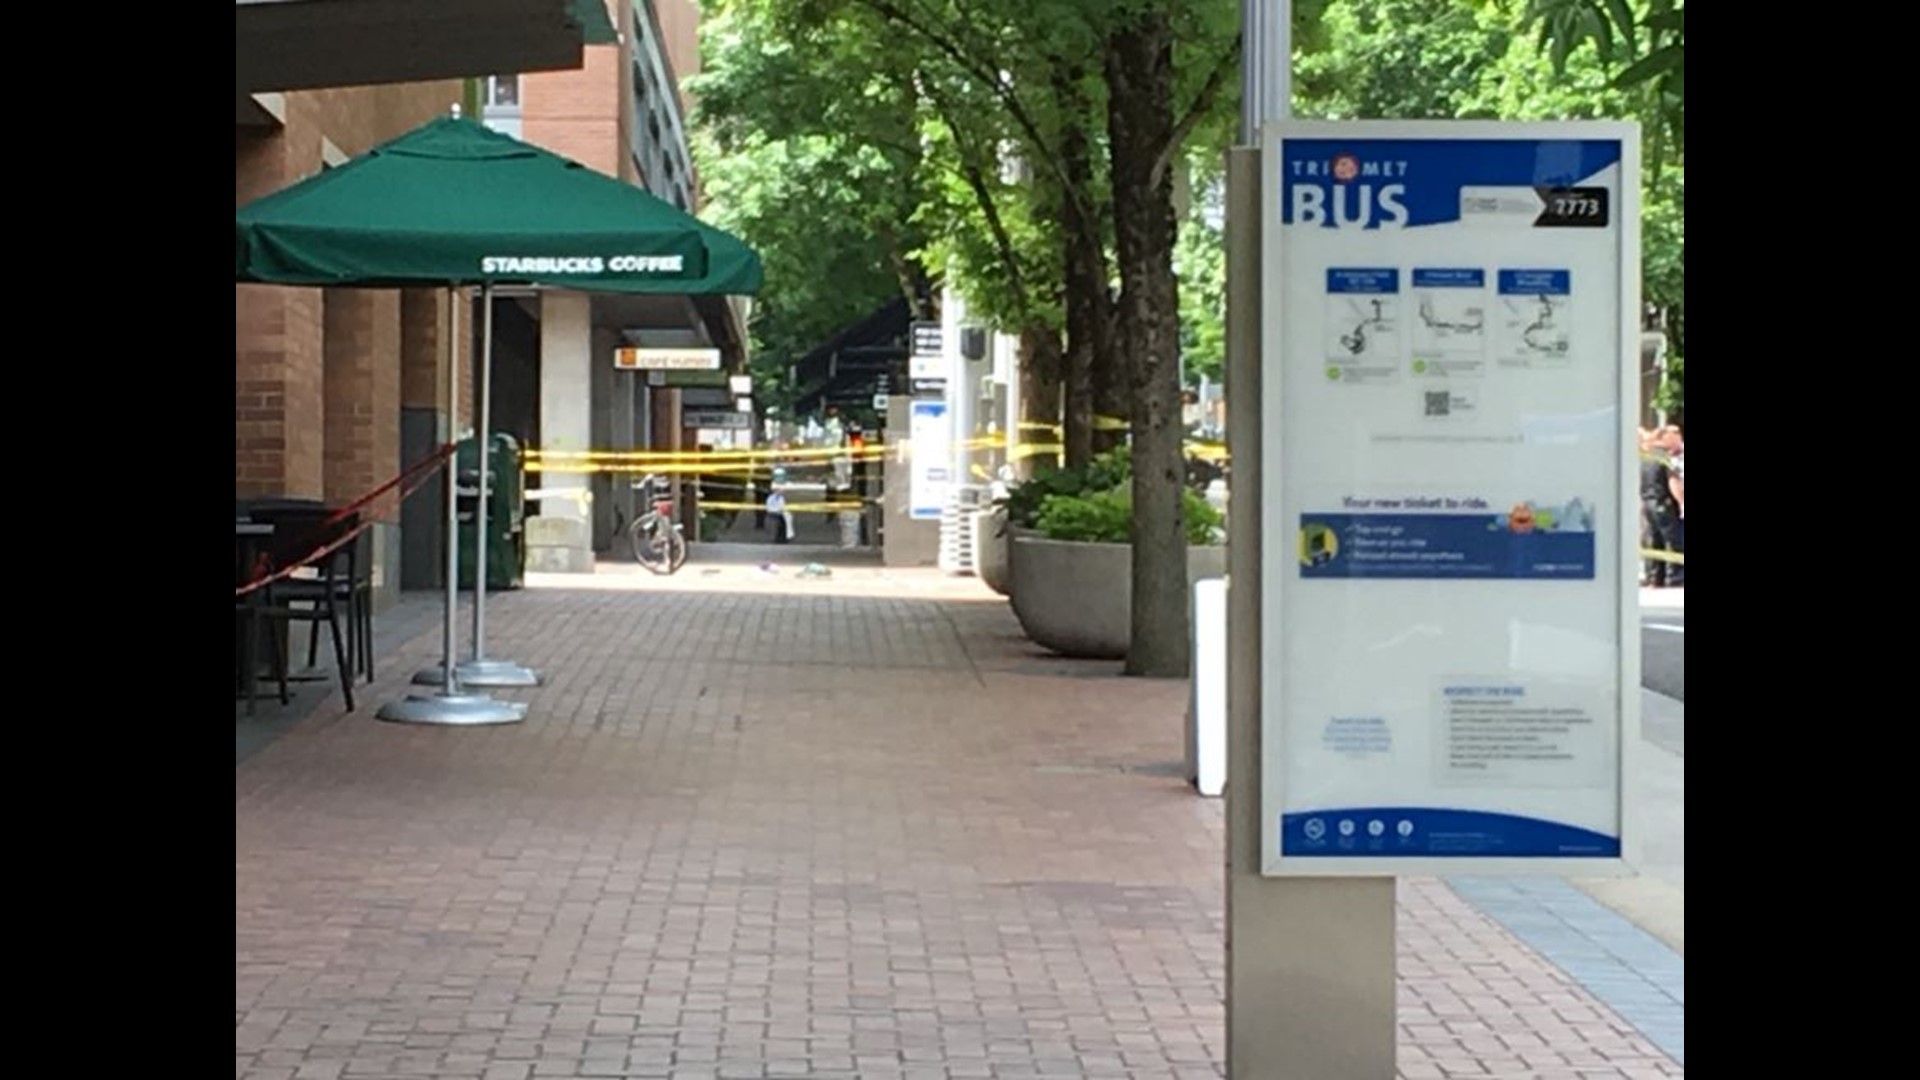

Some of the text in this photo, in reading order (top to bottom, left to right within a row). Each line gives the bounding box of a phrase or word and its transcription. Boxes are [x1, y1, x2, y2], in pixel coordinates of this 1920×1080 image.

[1362, 161, 1408, 177] MET
[1292, 184, 1409, 230] BUS
[482, 255, 684, 273] STARBUCKS COFFEE
[1445, 497, 1459, 509] to
